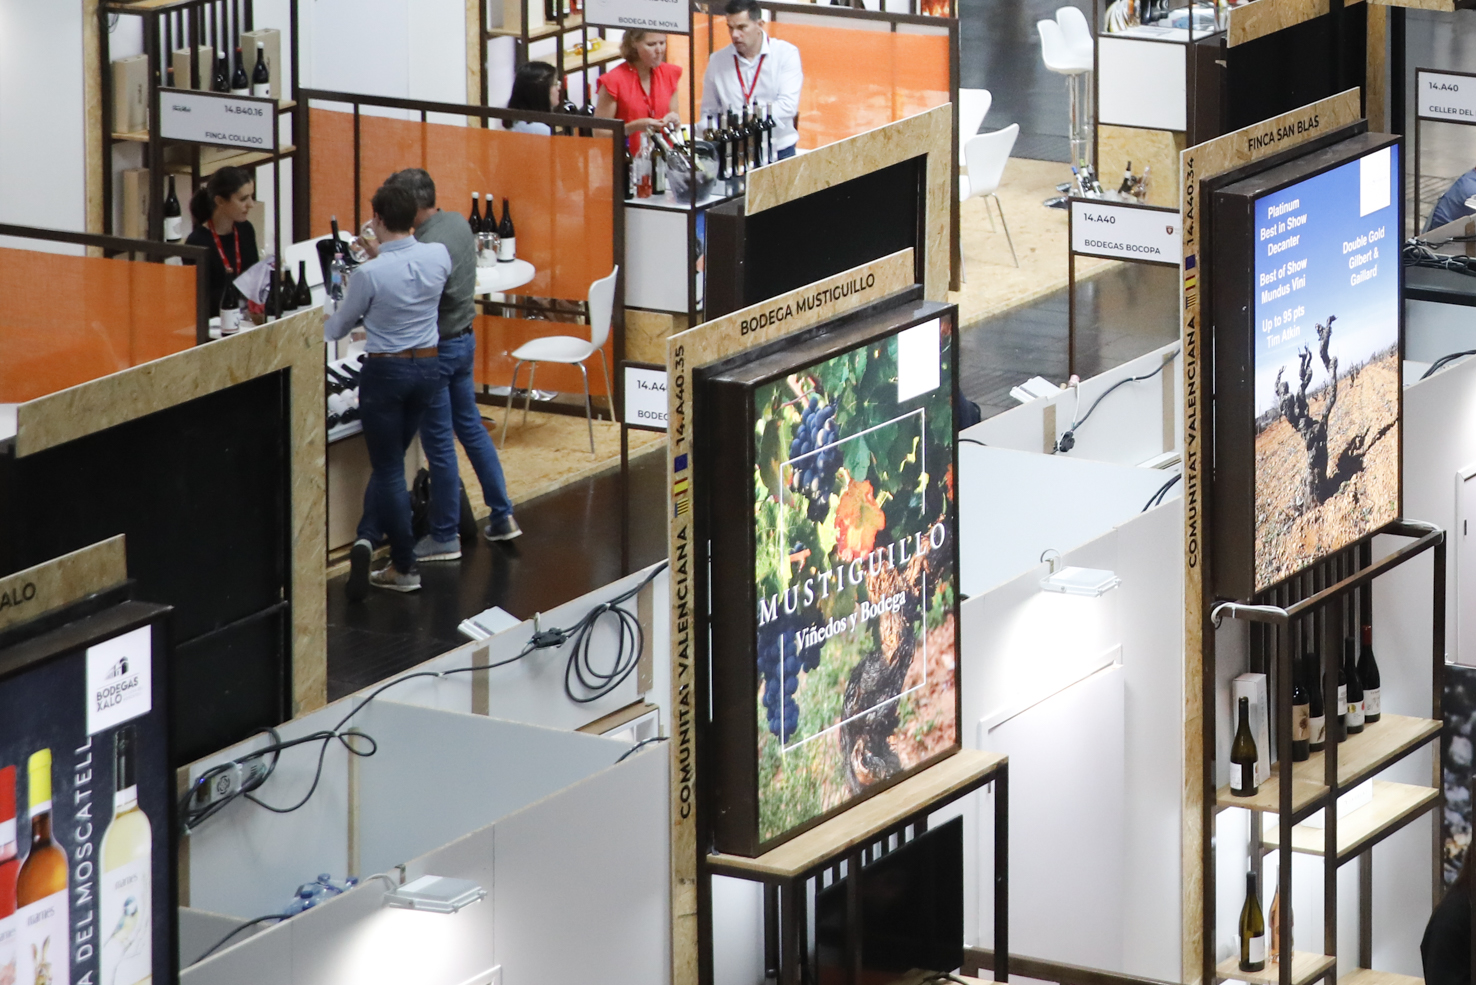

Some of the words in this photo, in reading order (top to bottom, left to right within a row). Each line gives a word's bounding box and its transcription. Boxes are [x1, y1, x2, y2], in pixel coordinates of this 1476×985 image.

[618, 16, 647, 26] BODEGA
[648, 19, 661, 27] DE
[663, 20, 679, 29] MOYA
[1429, 82, 1459, 93] 14.A40
[224, 104, 264, 117] 14.B40.16
[1429, 106, 1457, 115] CELLER
[1459, 108, 1476, 117] DEL
[204, 131, 227, 141] FINCA
[227, 134, 264, 145] COLLADO
[1248, 131, 1276, 152] FINCA
[1276, 124, 1296, 141] SAN
[1298, 114, 1320, 133] BLAS
[1187, 157, 1195, 246] 14.A40.34
[1268, 198, 1300, 219] Platinum
[1084, 213, 1117, 225] 14.A40
[1260, 227, 1278, 242] Best
[1278, 224, 1286, 237] in
[1287, 213, 1308, 234] Show
[1085, 239, 1125, 252] BODEGAS
[1125, 243, 1162, 256] BOCOPA
[1267, 234, 1301, 257] Decanter
[1342, 235, 1368, 255] Double
[1368, 225, 1386, 243] Gold
[1260, 272, 1278, 287] Best
[1279, 265, 1288, 280] of
[1288, 258, 1308, 278] Show
[1349, 251, 1373, 270] Gilbert
[1373, 246, 1380, 258] &
[1261, 284, 1291, 305] Mundus
[1292, 276, 1307, 294] Vini
[1350, 266, 1378, 286] Gaillard
[740, 302, 794, 337] BODEGA
[796, 272, 876, 315] MUSTIGUILLO
[1262, 318, 1273, 334] Up
[1274, 315, 1282, 330] to
[1283, 311, 1294, 325] 95
[1294, 305, 1305, 325] pts
[1266, 333, 1281, 349] Tim
[1281, 325, 1300, 343] Atkin
[674, 345, 686, 447] 14.A40.35
[1187, 317, 1197, 446] VALENCIANA
[1188, 451, 1197, 569] COMUNITAT
[758, 522, 948, 626] MUSTIGUILLO
[676, 524, 689, 669] VALENCIANA
[796, 608, 847, 650] Viñedos
[848, 608, 858, 629] y
[859, 591, 908, 624] Bodega
[96, 676, 139, 702] BODEGAS
[679, 671, 691, 818] COMUNITAT
[74, 737, 95, 902] MOSCATELL
[75, 909, 94, 958] DEL
